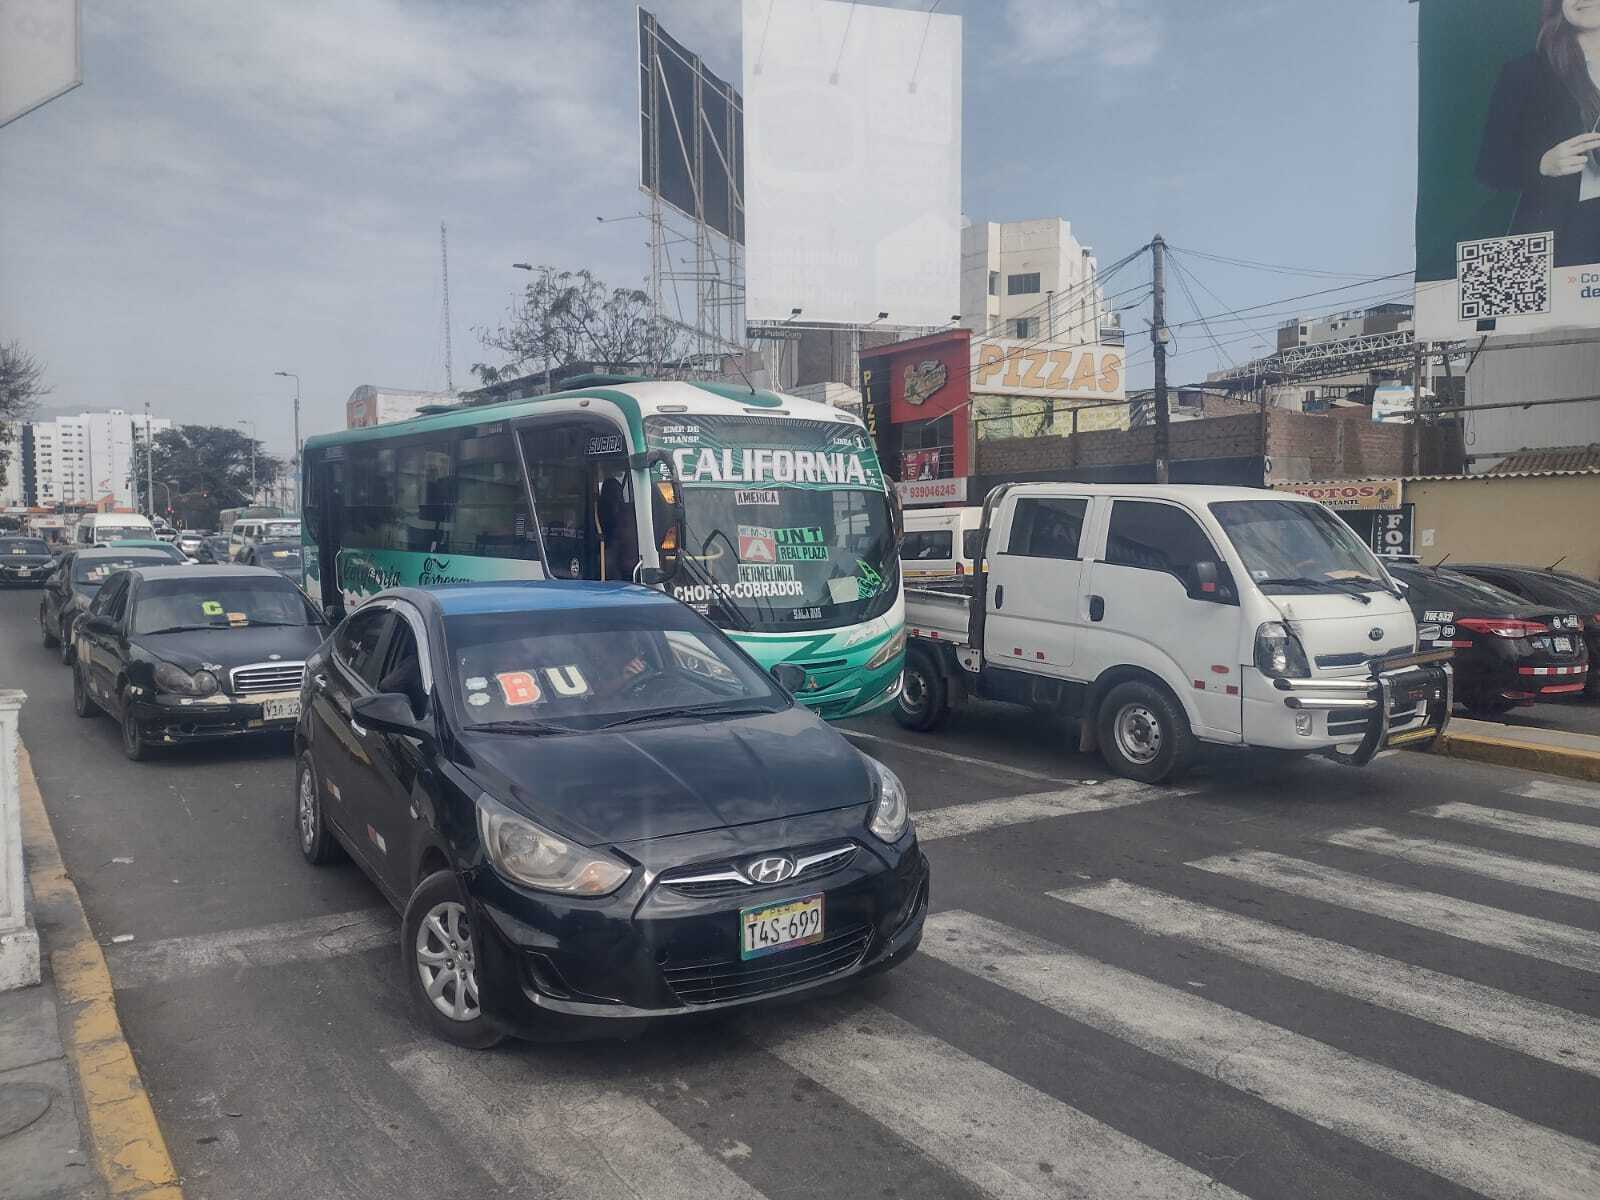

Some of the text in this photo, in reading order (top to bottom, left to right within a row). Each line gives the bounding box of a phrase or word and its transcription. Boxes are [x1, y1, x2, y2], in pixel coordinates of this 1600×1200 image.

[975, 343, 1122, 393] PIZZAS
[672, 446, 868, 486] CALIFORNIA
[738, 490, 777, 503] AMERICA
[774, 527, 821, 545] UNT
[744, 539, 773, 561] A
[780, 546, 828, 560] REAL PLAZA
[739, 564, 794, 582] HERMELINDA
[495, 665, 588, 705] B U
[747, 908, 820, 949] T4S-699
